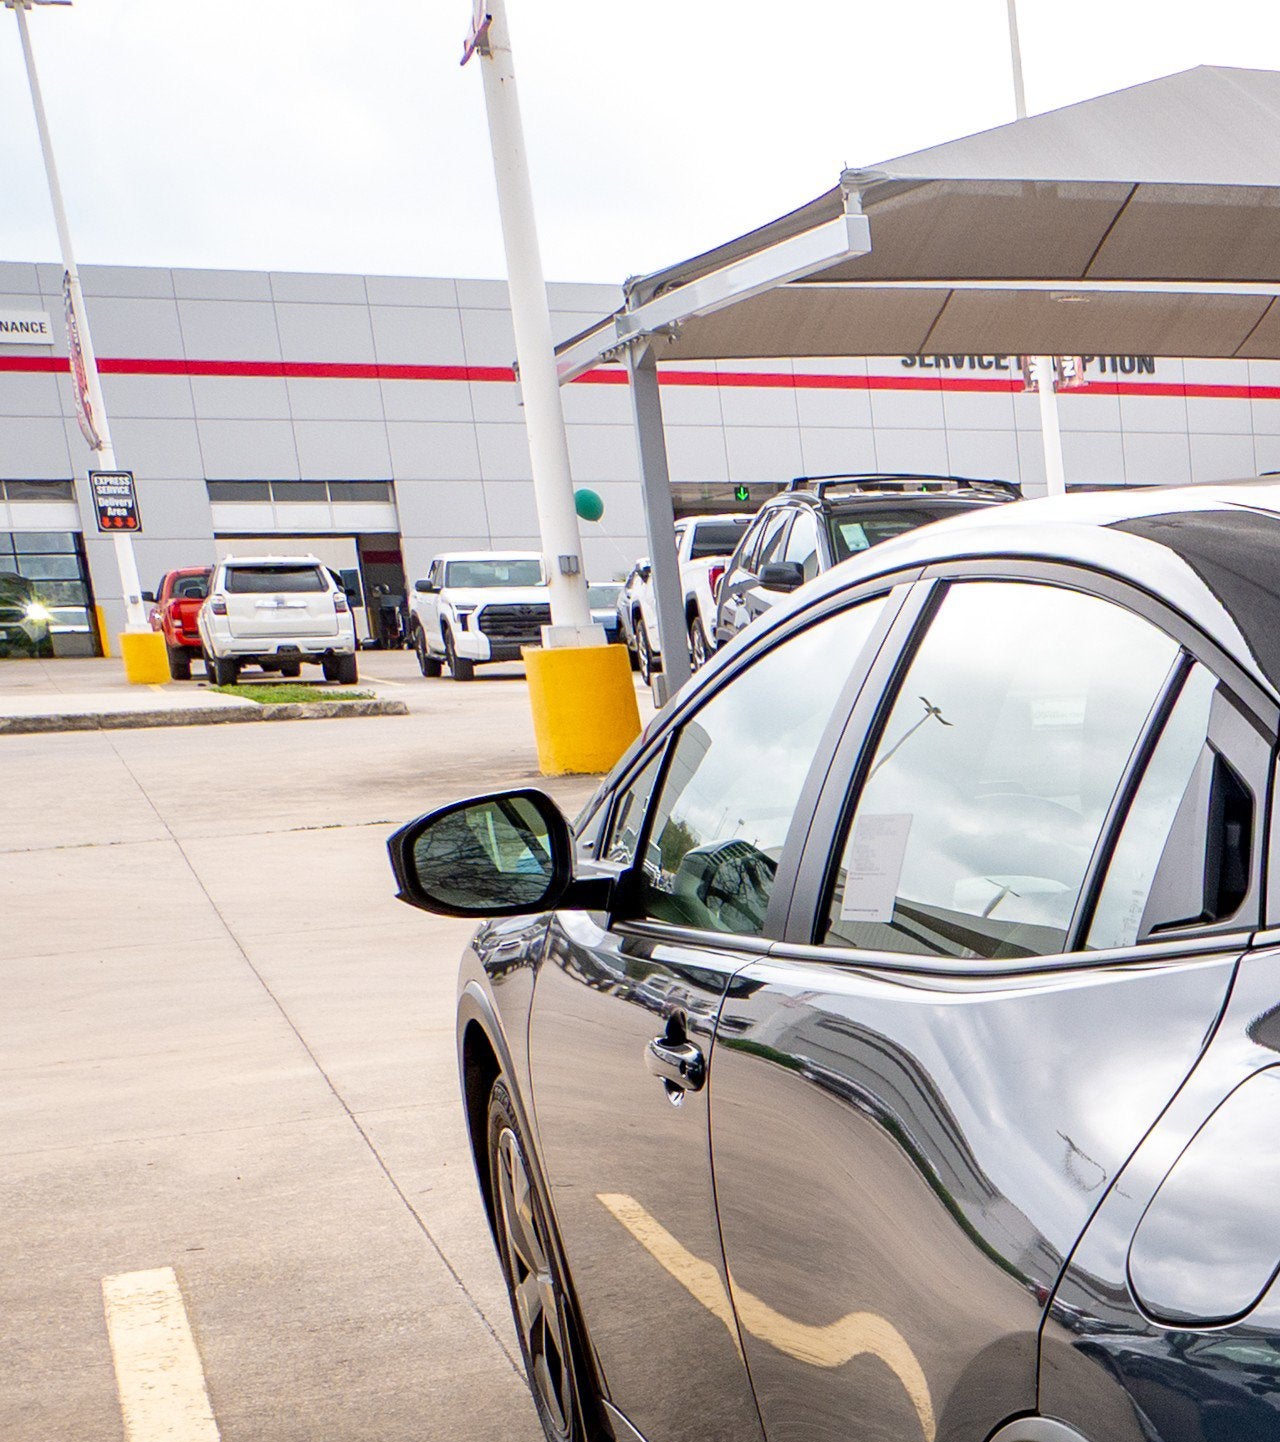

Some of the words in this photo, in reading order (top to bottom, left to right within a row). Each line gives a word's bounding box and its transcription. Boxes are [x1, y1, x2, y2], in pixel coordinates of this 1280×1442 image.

[93, 476, 131, 486] EXPRESS
[95, 485, 131, 496] SERVICE
[97, 497, 133, 508] Delivery
[107, 507, 128, 516] Area
